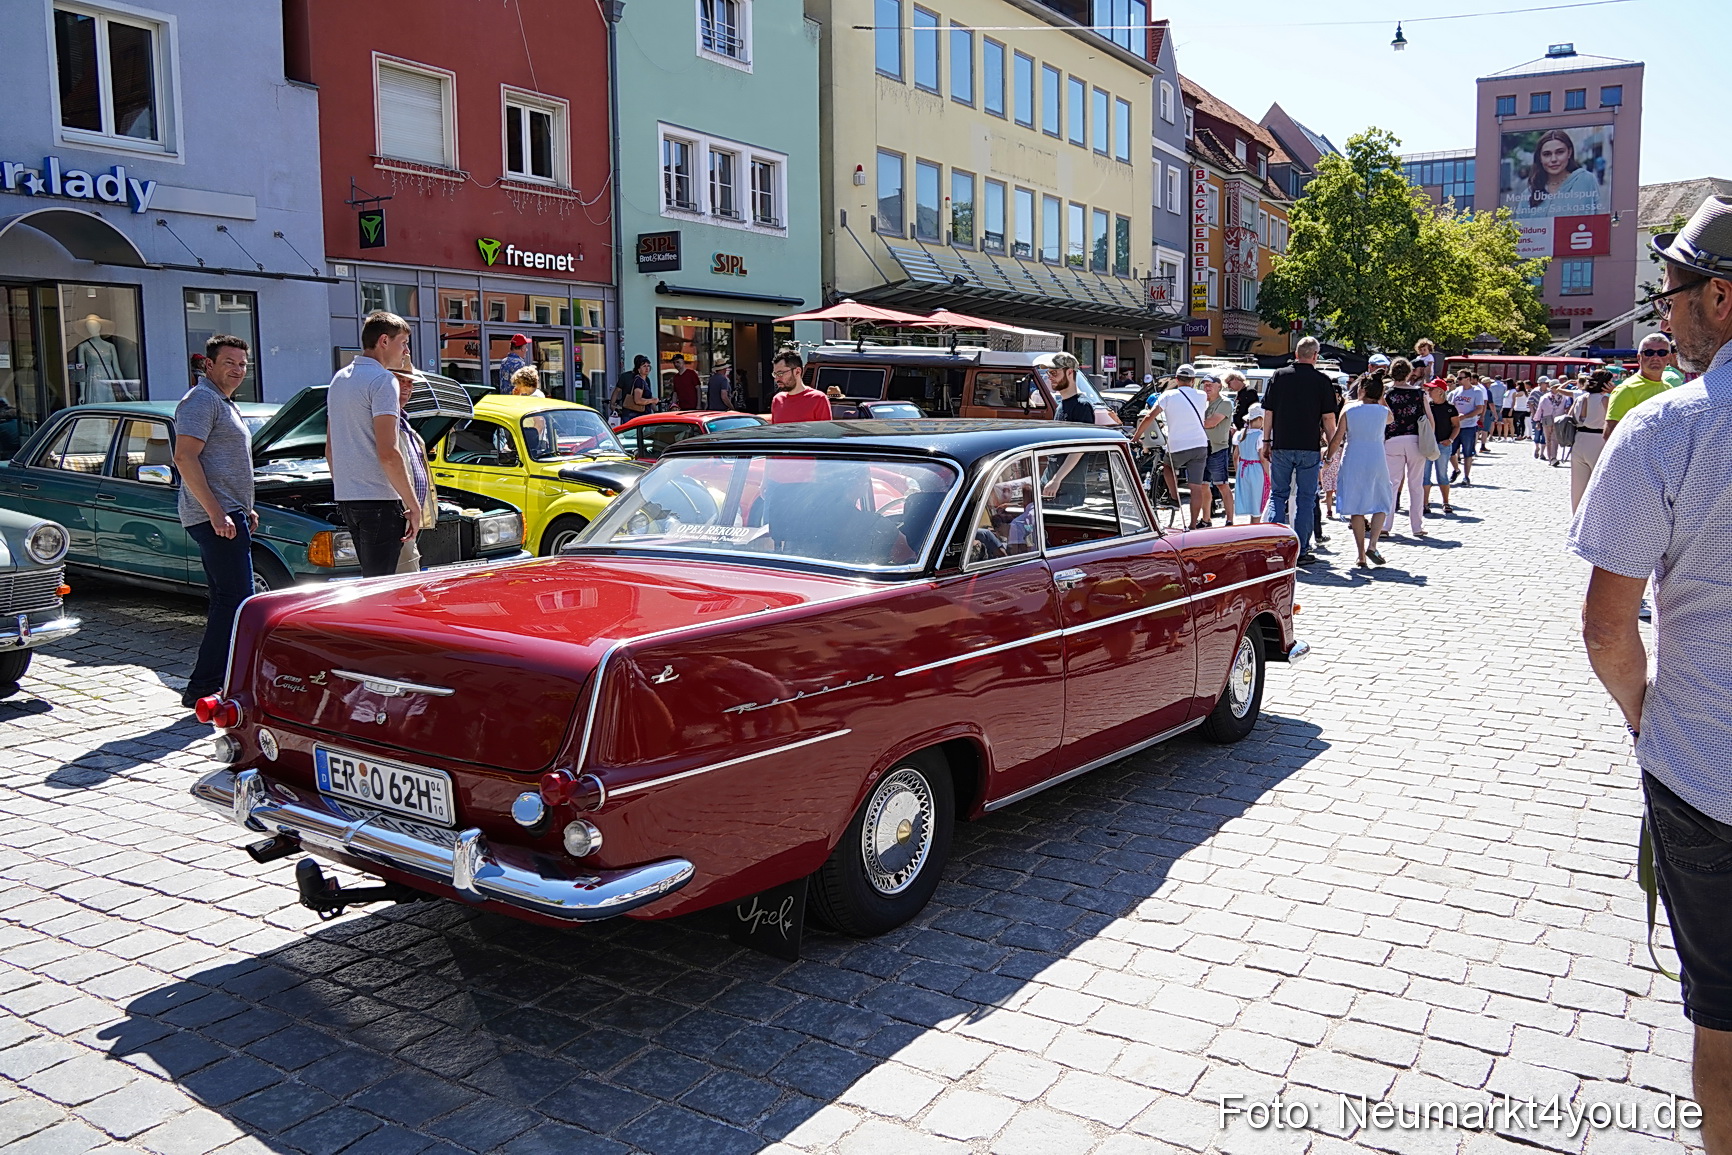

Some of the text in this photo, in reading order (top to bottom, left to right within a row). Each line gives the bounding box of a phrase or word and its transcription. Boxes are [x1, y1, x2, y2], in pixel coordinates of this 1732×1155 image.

[44, 156, 157, 213] lady
[1506, 189, 1599, 203] Mehr Überholspur.
[1550, 203, 1605, 215] Sackgasse.
[1518, 227, 1547, 235] bildung
[641, 236, 676, 253] SIPL
[505, 245, 575, 272] freenet
[711, 252, 748, 277] SIPL
[1193, 286, 1206, 295] café
[1549, 306, 1593, 317] arkasse
[677, 524, 750, 536] OPEL REKORD
[329, 756, 358, 794] ER
[389, 771, 432, 813] 62H
